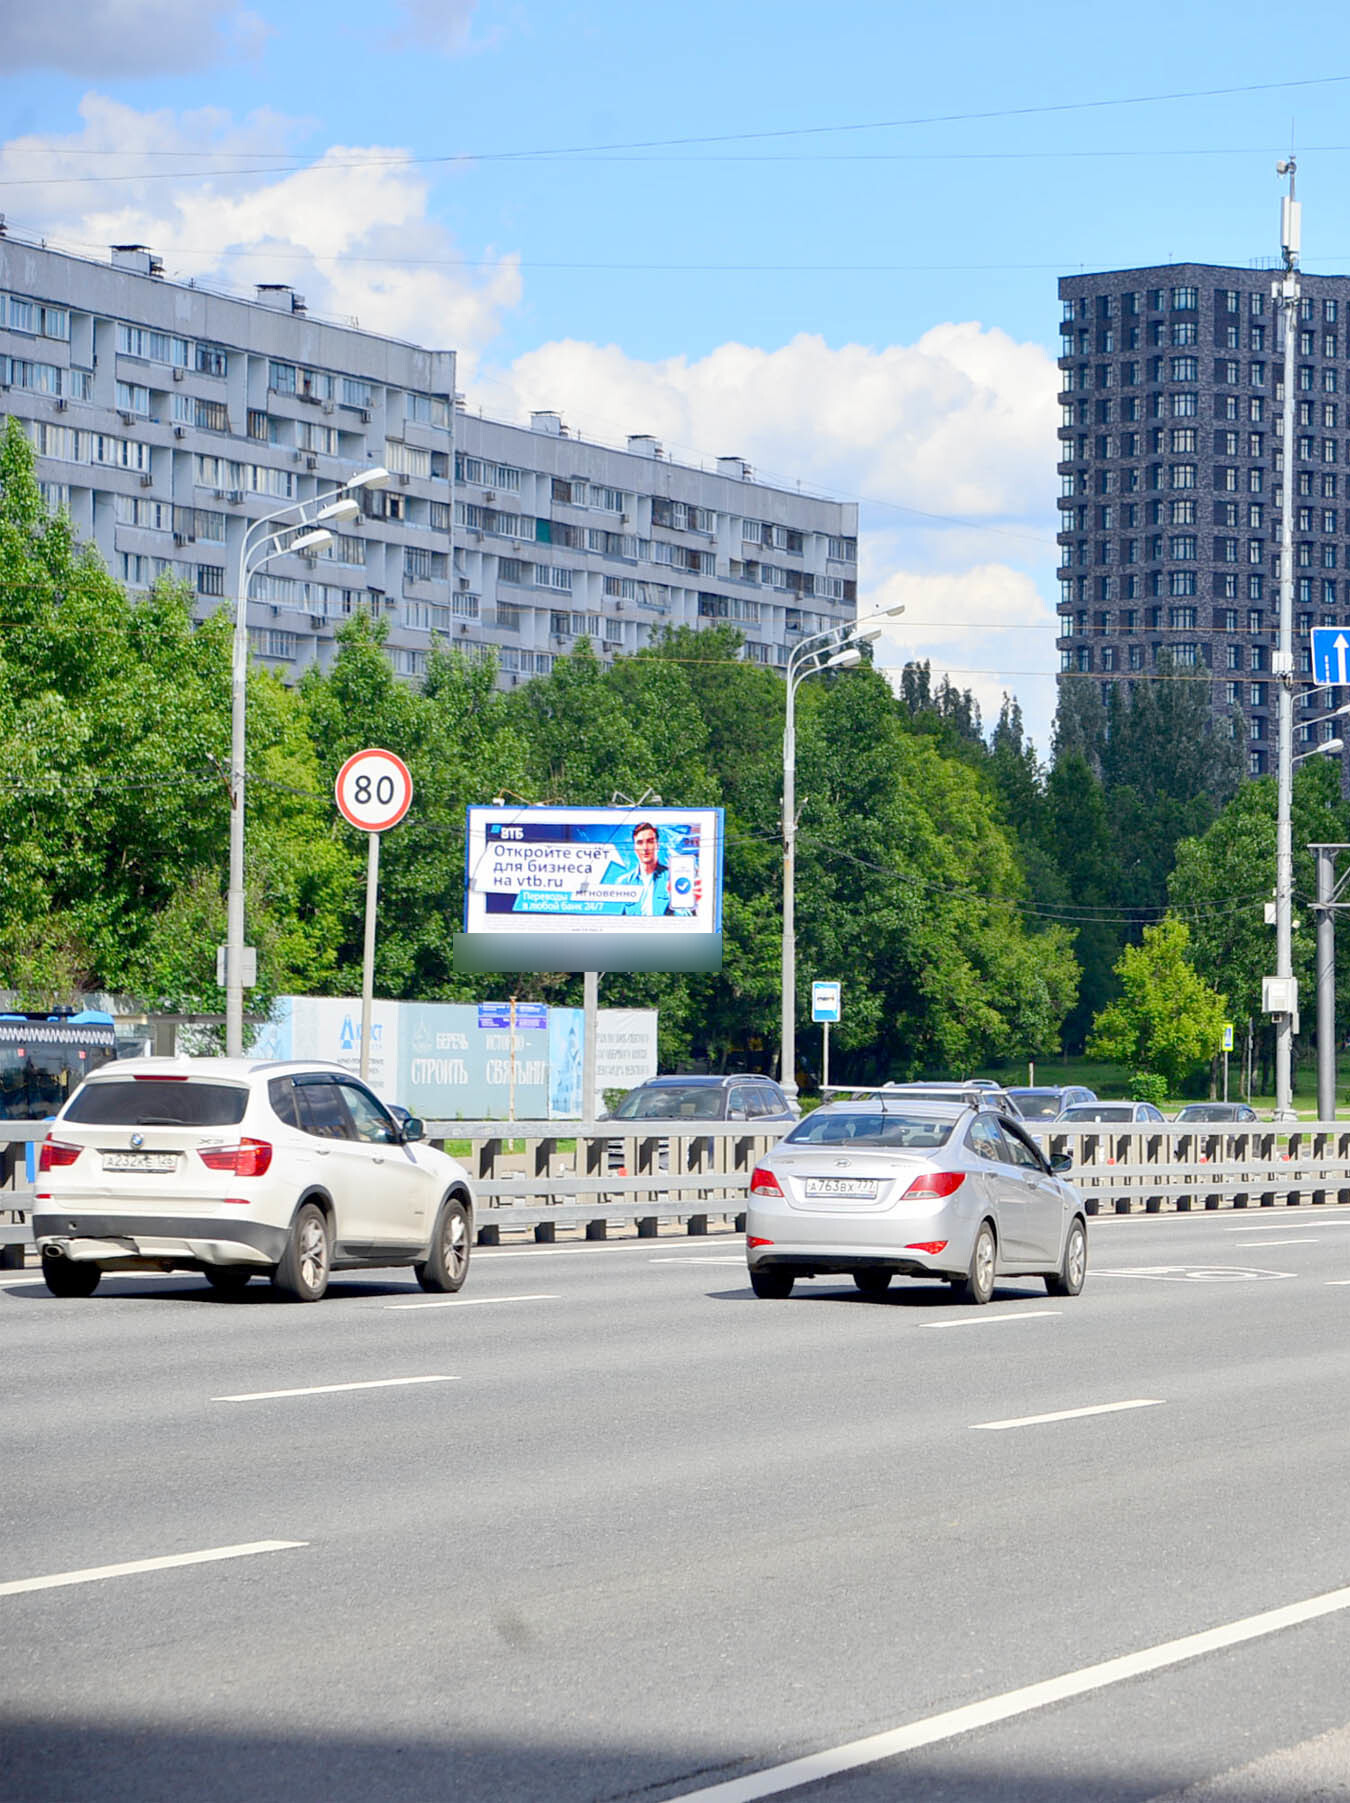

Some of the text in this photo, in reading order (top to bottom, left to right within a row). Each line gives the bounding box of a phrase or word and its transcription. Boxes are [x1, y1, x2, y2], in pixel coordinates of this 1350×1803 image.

[354, 774, 394, 804] 80
[501, 827, 523, 839] ВТБ
[494, 845, 610, 859] Откройте счёт
[494, 860, 592, 873] для бизнеса
[494, 875, 563, 887] на vtb.ru
[411, 1059, 469, 1084] СТРОИТЬ
